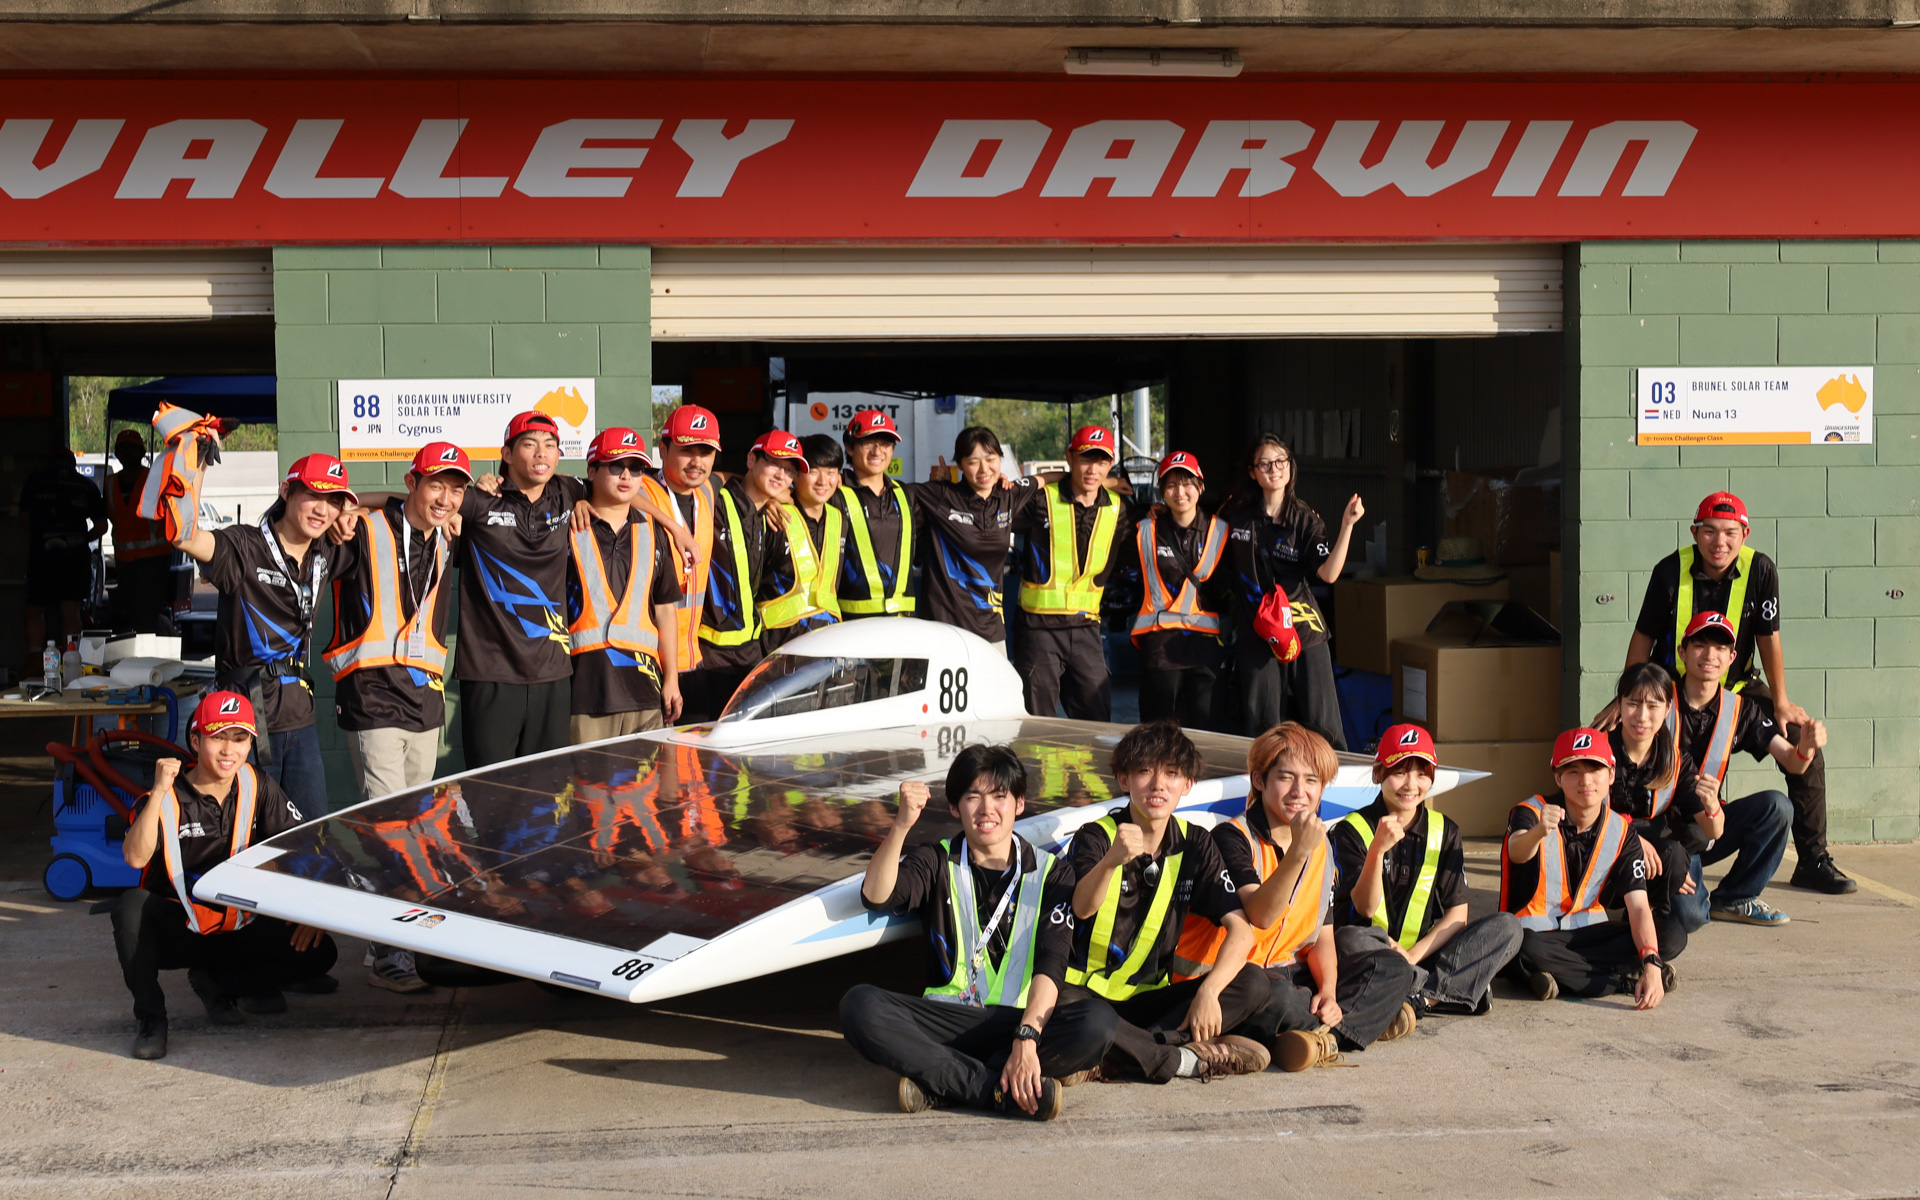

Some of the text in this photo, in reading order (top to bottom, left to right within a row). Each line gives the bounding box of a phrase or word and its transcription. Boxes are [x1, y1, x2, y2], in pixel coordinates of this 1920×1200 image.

[0, 118, 1699, 199] VALLEY DARWIN
[1691, 380, 1789, 391] BRUNEL SOLAR TEAM
[1651, 381, 1676, 404] 03
[397, 393, 512, 404] KOGAKUIN UNIVERSITY
[353, 394, 380, 418] 88
[397, 406, 461, 416] SOLAR TEAM
[1663, 409, 1681, 420] NED
[1692, 409, 1737, 420] Nuna 13
[367, 424, 382, 434] JPN
[398, 423, 443, 437] Cygnus
[1674, 435, 1706, 443] Challenger
[939, 667, 968, 714] 88
[611, 958, 655, 981] 88
